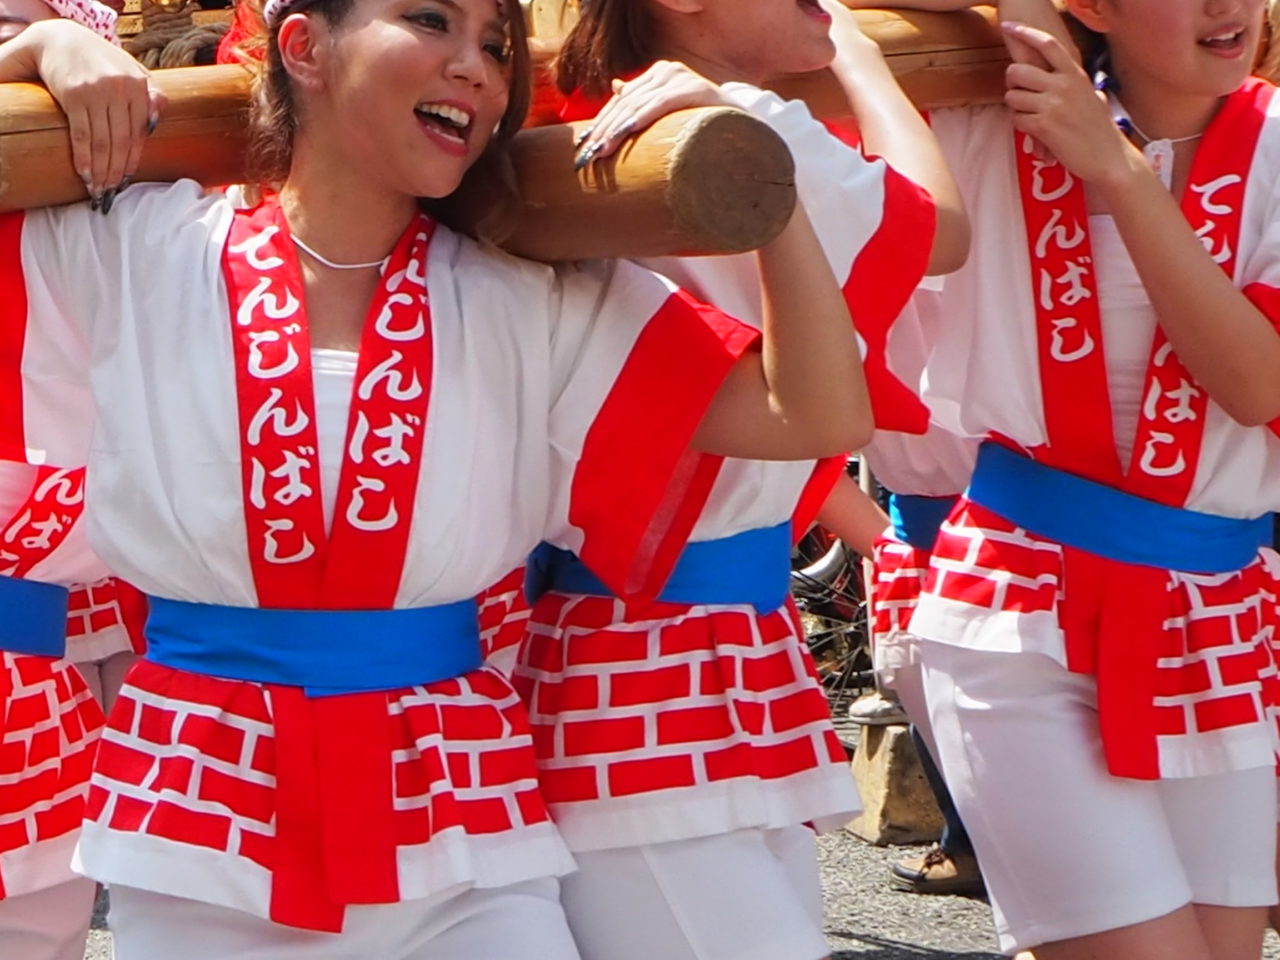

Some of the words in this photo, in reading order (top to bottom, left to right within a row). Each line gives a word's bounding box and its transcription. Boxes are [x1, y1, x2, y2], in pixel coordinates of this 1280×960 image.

[233, 226, 317, 565] てんじんばし
